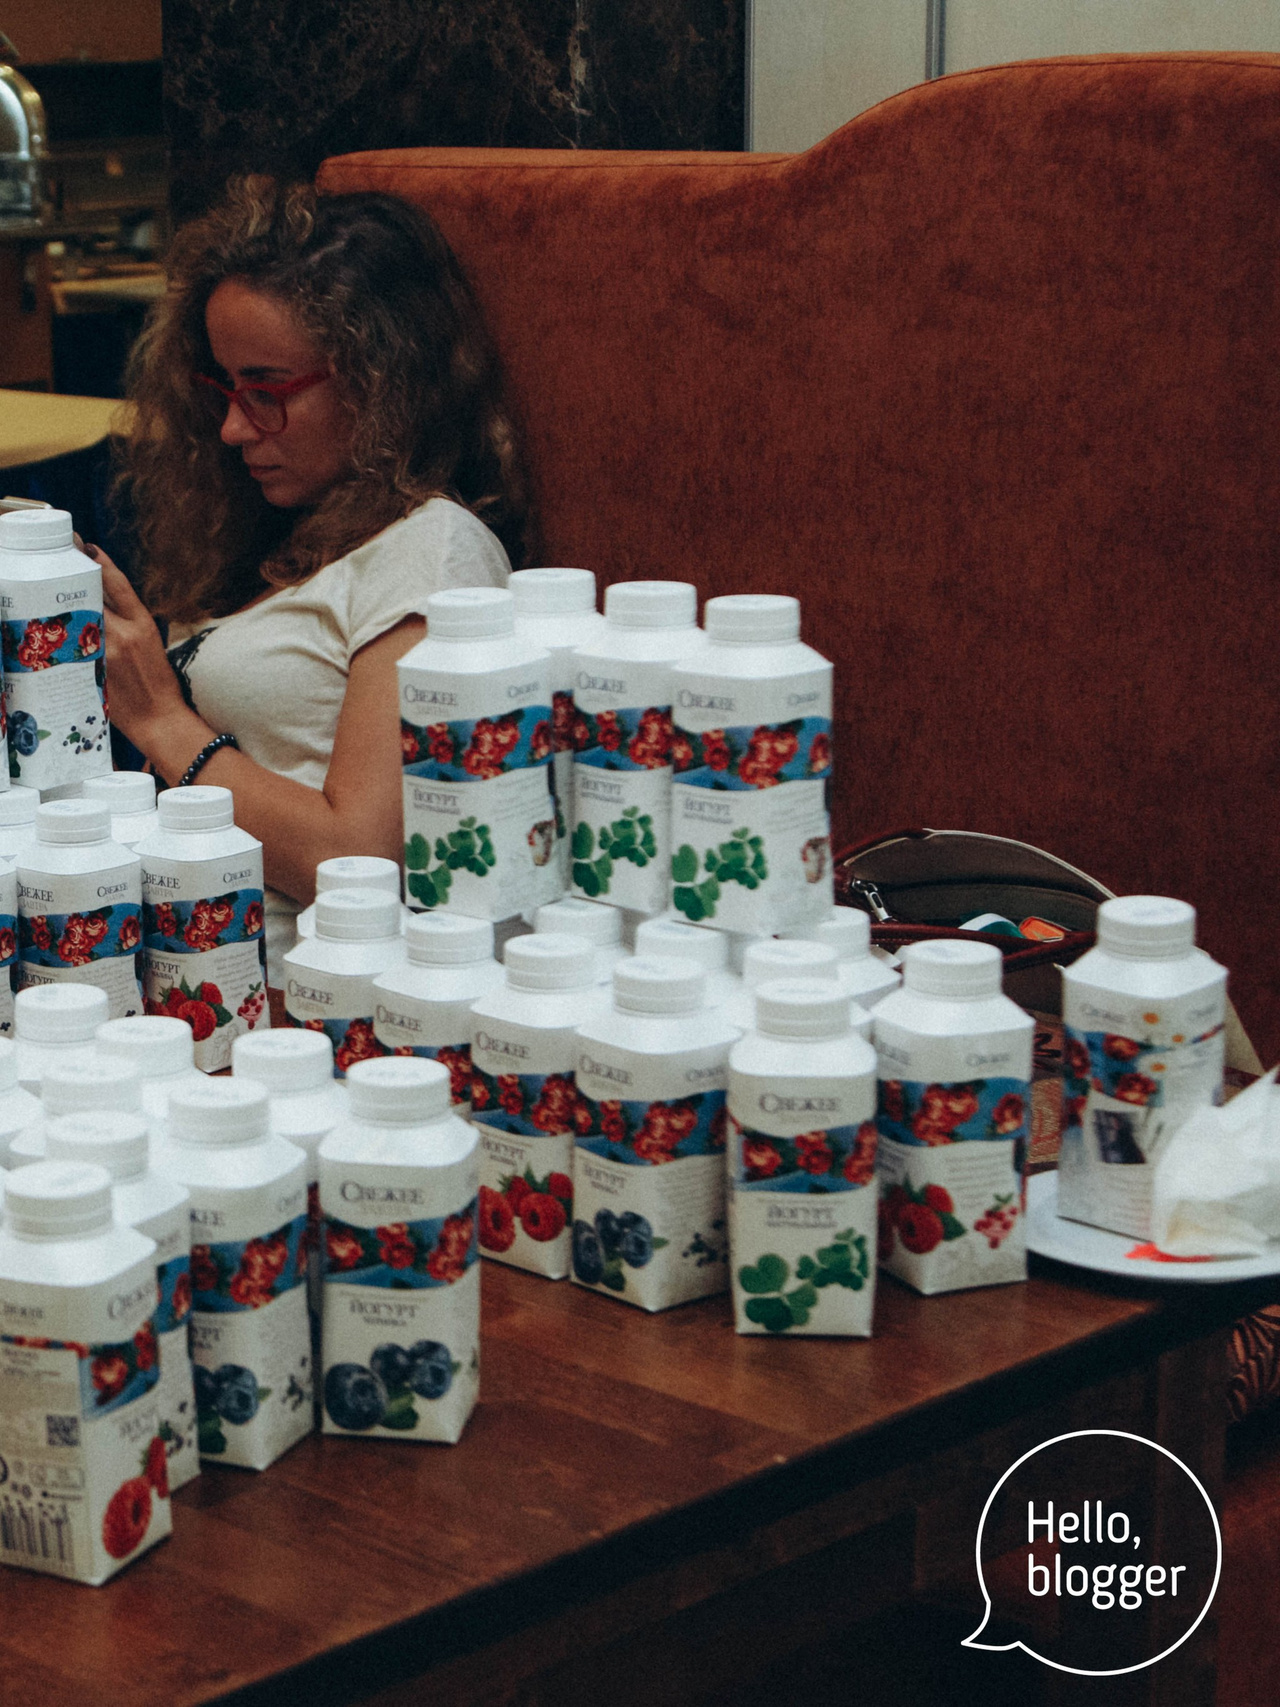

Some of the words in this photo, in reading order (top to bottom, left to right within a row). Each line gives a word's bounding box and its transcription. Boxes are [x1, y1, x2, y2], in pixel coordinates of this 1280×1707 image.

[56, 590, 88, 604] СВЕЖЕЕ
[223, 869, 253, 884] СВЕЖЕЕ
[97, 882, 128, 898] СВЕЖЕЕ
